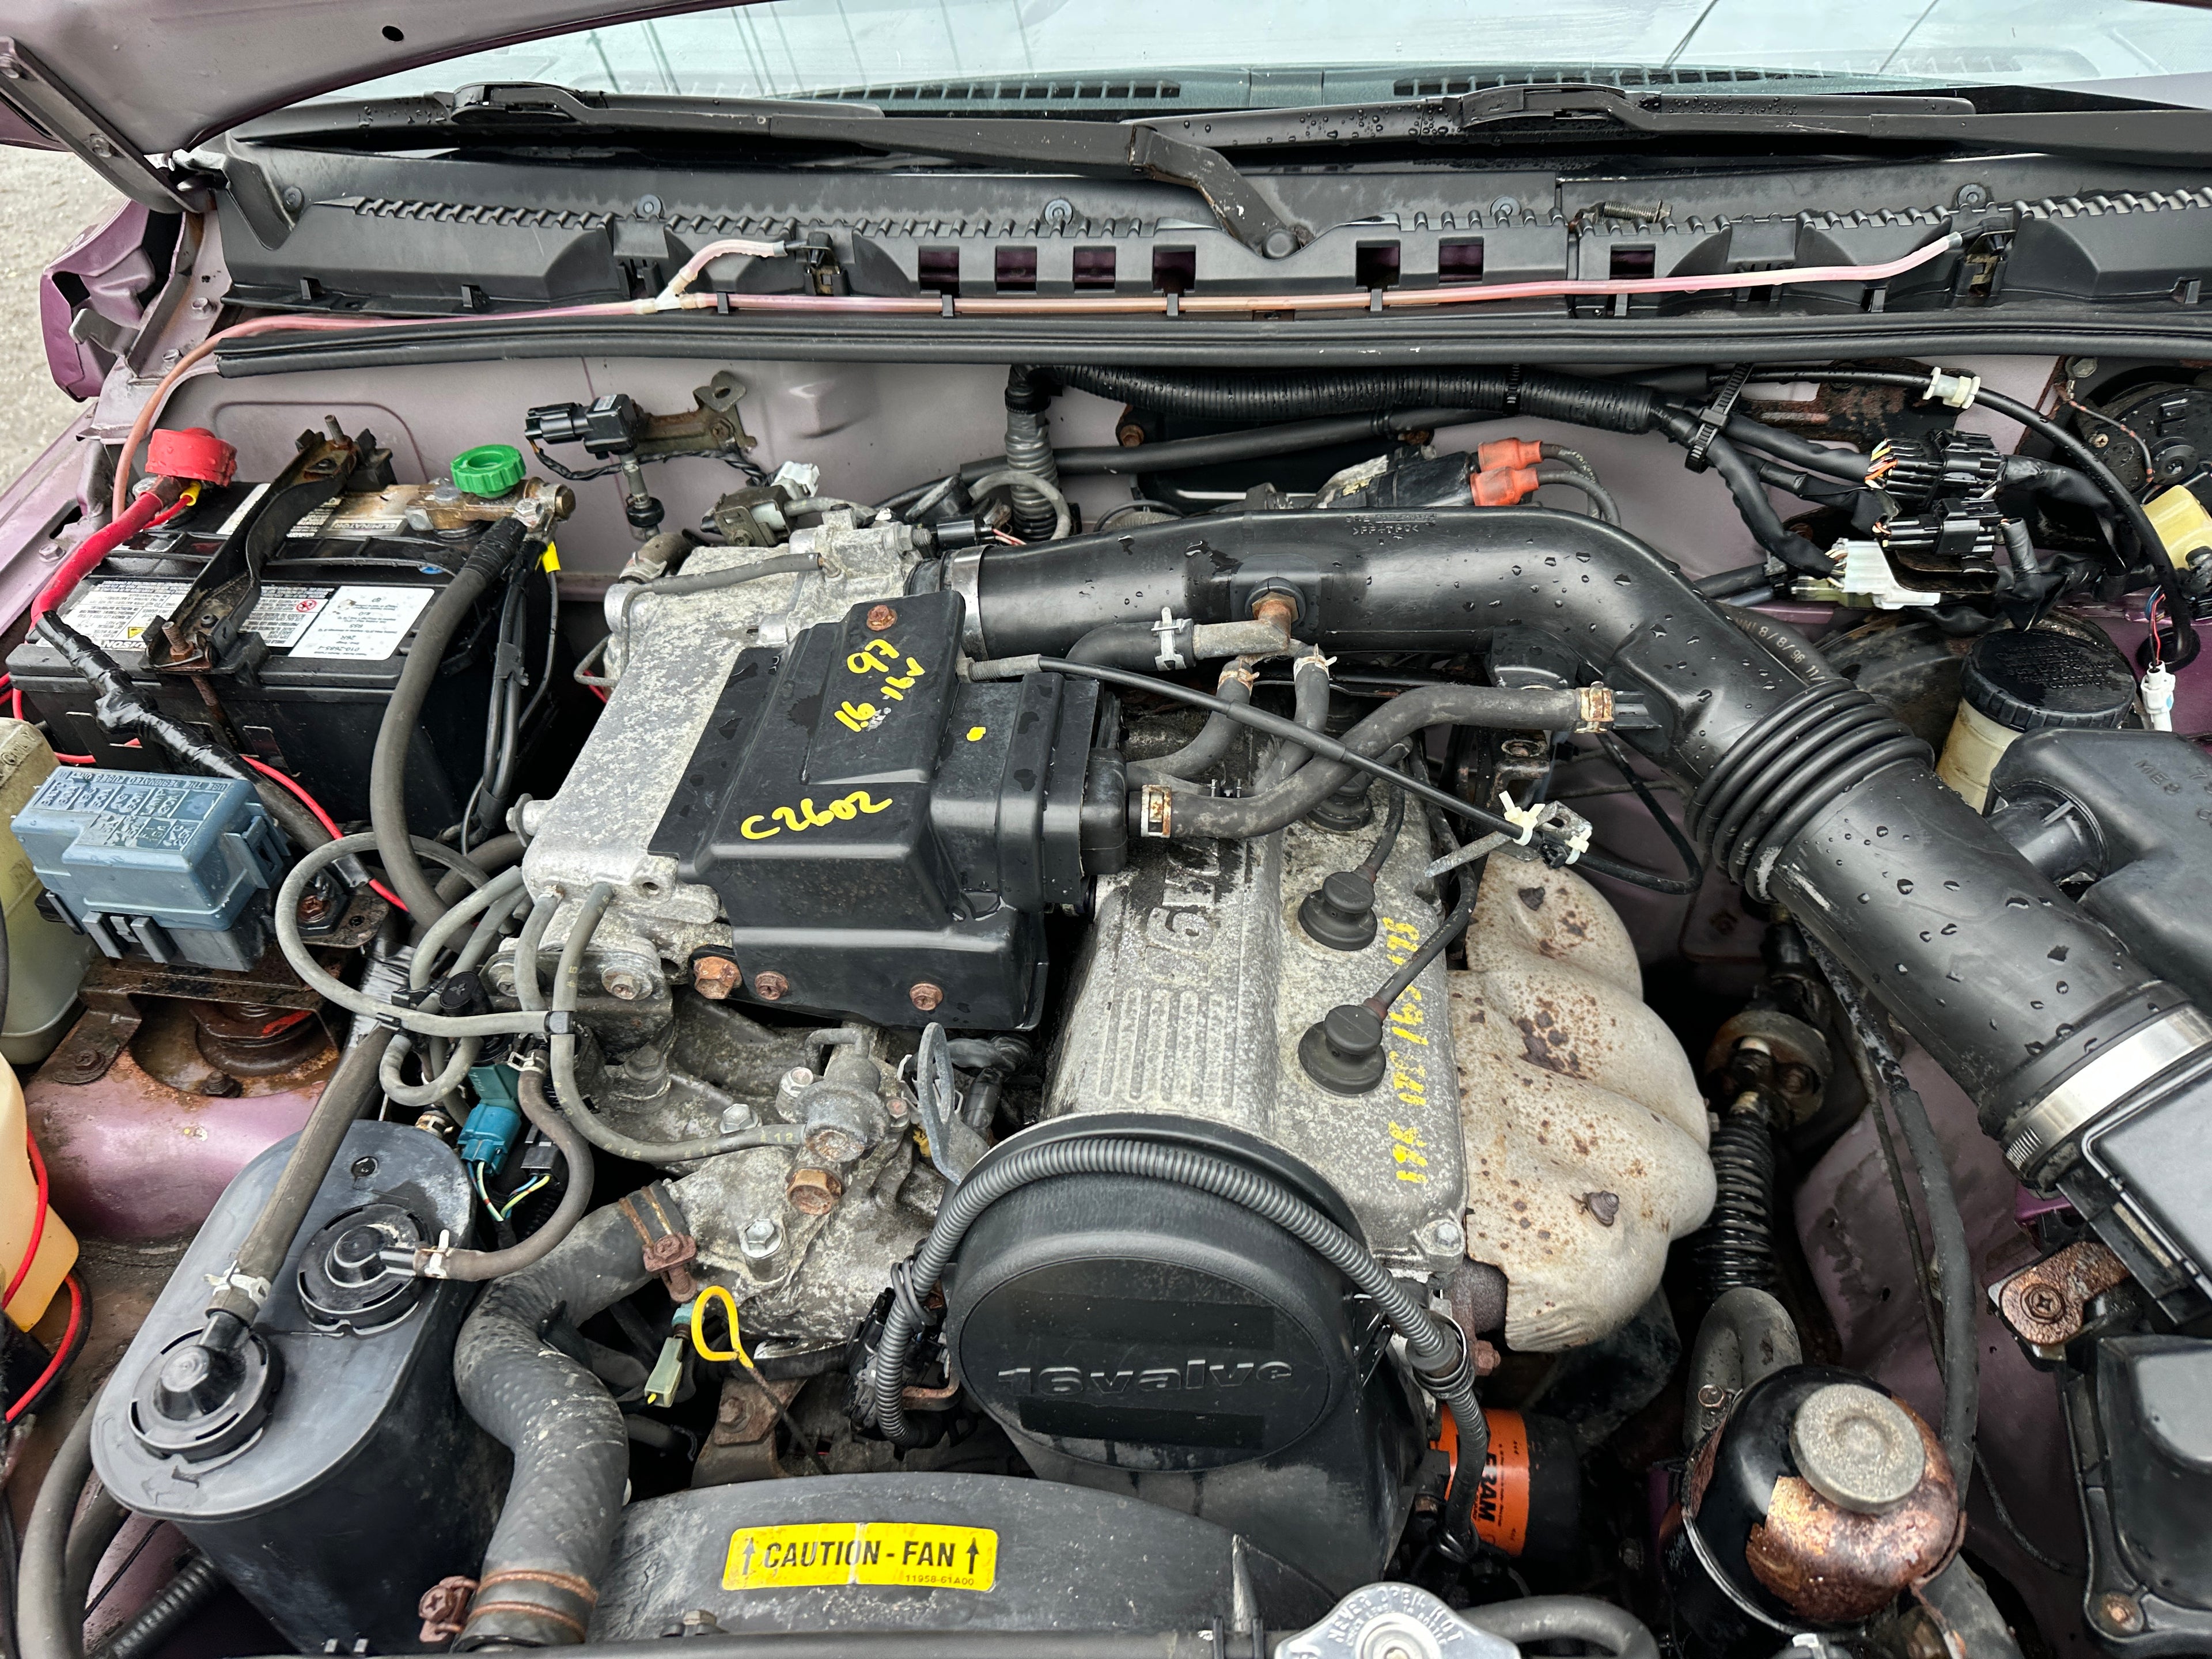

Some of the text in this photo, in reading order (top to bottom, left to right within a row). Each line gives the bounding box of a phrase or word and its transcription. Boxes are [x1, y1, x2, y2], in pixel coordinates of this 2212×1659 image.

[104, 641, 147, 649] OISON
[846, 638, 899, 675] 97
[740, 790, 892, 840] C2602
[1478, 1451, 1497, 1522] FRAM
[763, 1540, 881, 1569] CAUTION
[902, 1540, 956, 1569] FAN
[905, 1574, 975, 1586] 11958-61A00
